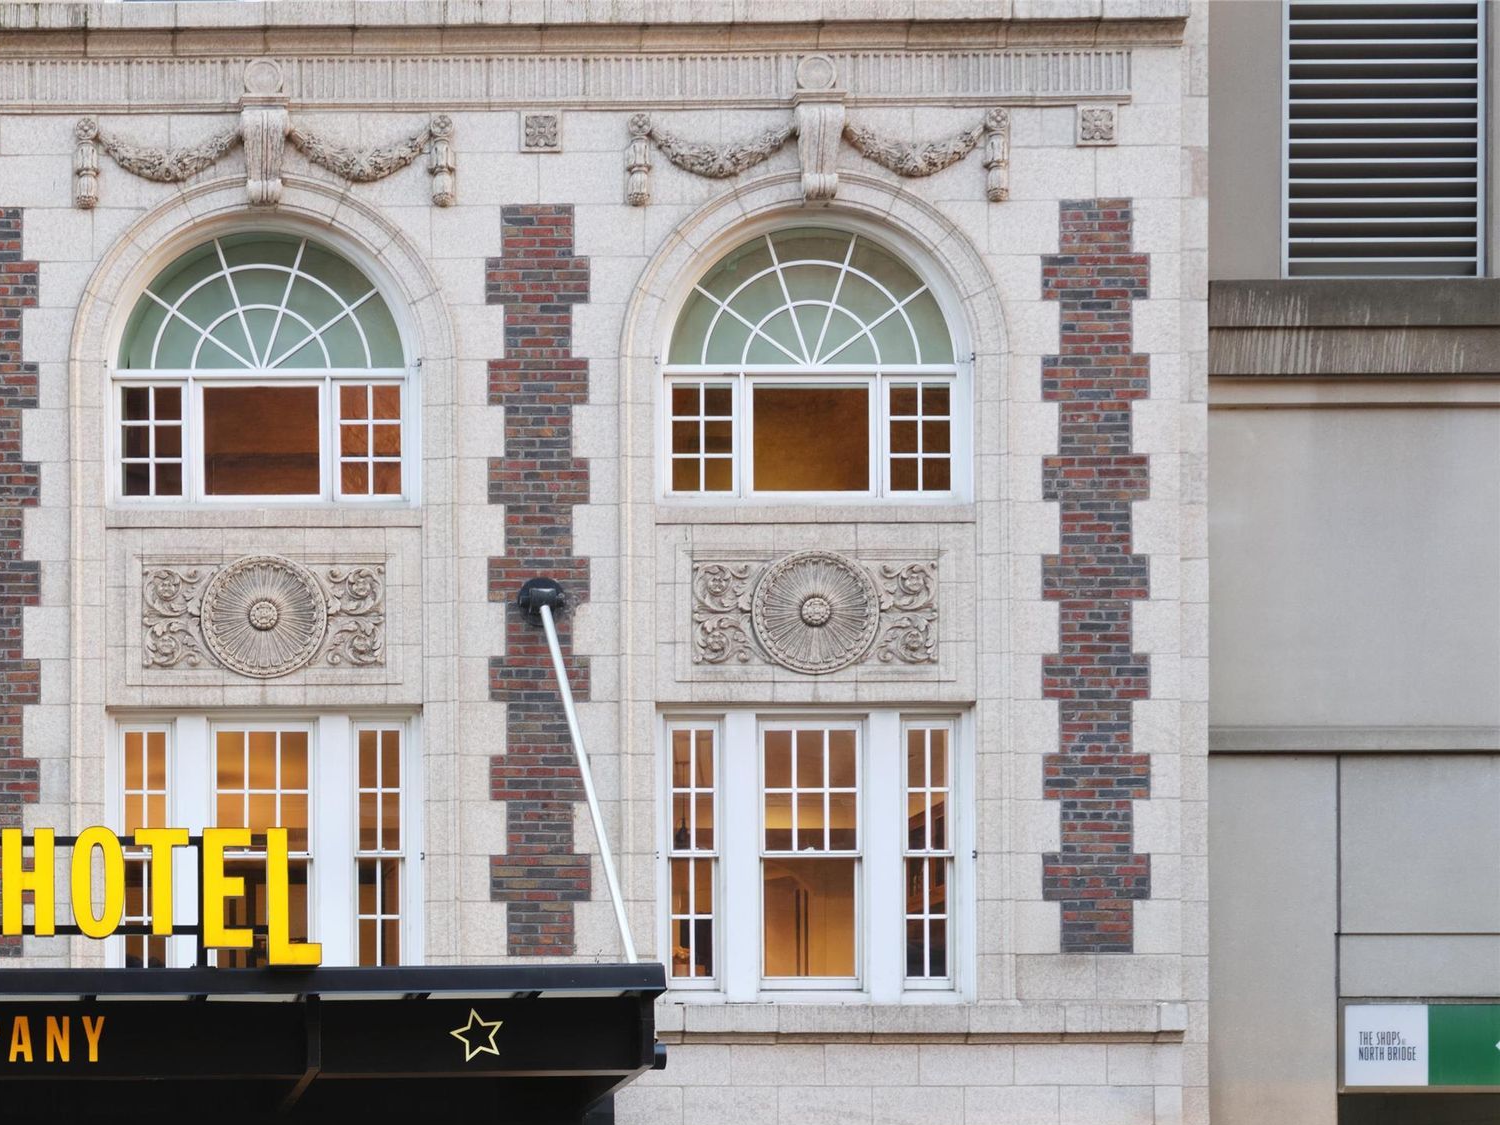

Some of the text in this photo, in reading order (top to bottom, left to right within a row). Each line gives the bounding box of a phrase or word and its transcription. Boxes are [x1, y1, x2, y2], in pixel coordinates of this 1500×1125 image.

[1, 826, 322, 966] HOTEL
[1359, 1031, 1373, 1046] THE
[1376, 1031, 1401, 1046] SHOPS
[1358, 1046, 1416, 1061] NORTH BRIDGE
